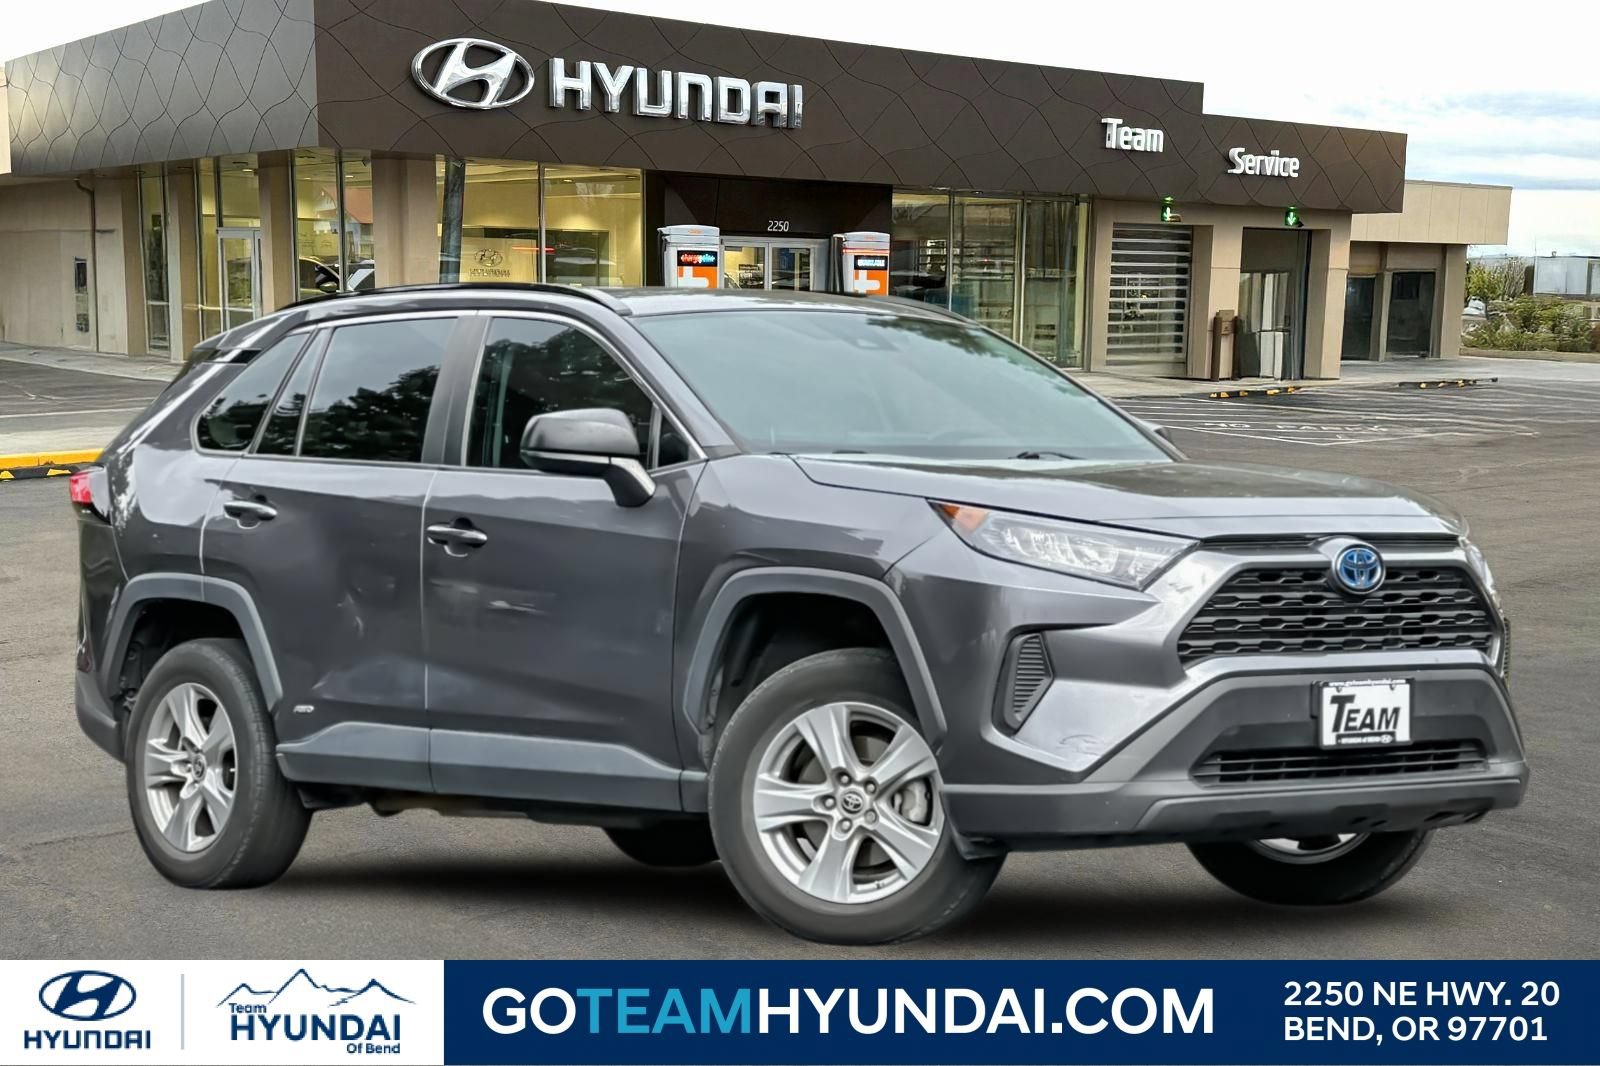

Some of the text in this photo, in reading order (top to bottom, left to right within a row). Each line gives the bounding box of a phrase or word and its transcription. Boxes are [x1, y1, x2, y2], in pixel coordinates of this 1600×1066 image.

[548, 57, 803, 129] HYUNDAI
[1101, 117, 1164, 152] Team
[1227, 147, 1300, 178] Service
[767, 220, 790, 232] 2250
